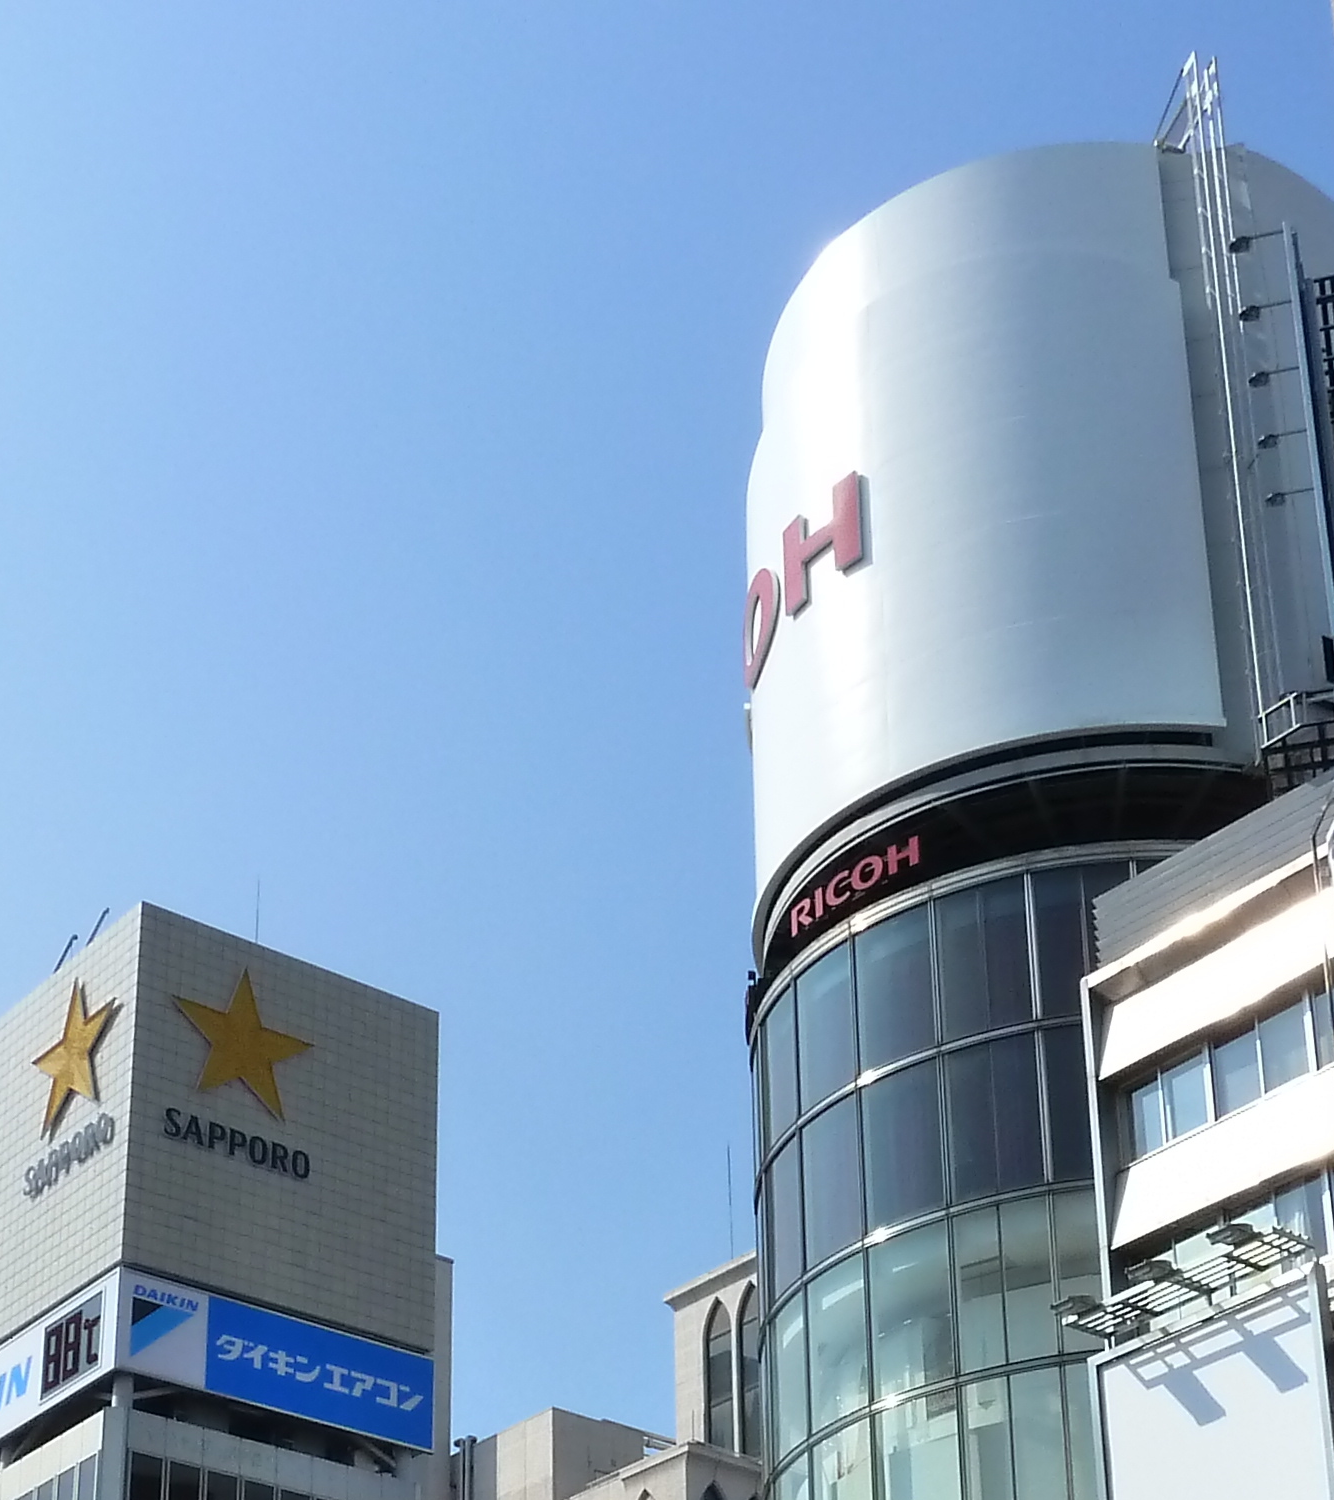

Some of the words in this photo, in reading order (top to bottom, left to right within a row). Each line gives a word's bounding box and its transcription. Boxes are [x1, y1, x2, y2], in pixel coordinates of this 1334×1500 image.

[789, 835, 921, 938] RICOH
[22, 1110, 116, 1201] SAPPORO
[163, 1105, 312, 1181] SAPPORO
[132, 1282, 200, 1313] DAIKIN
